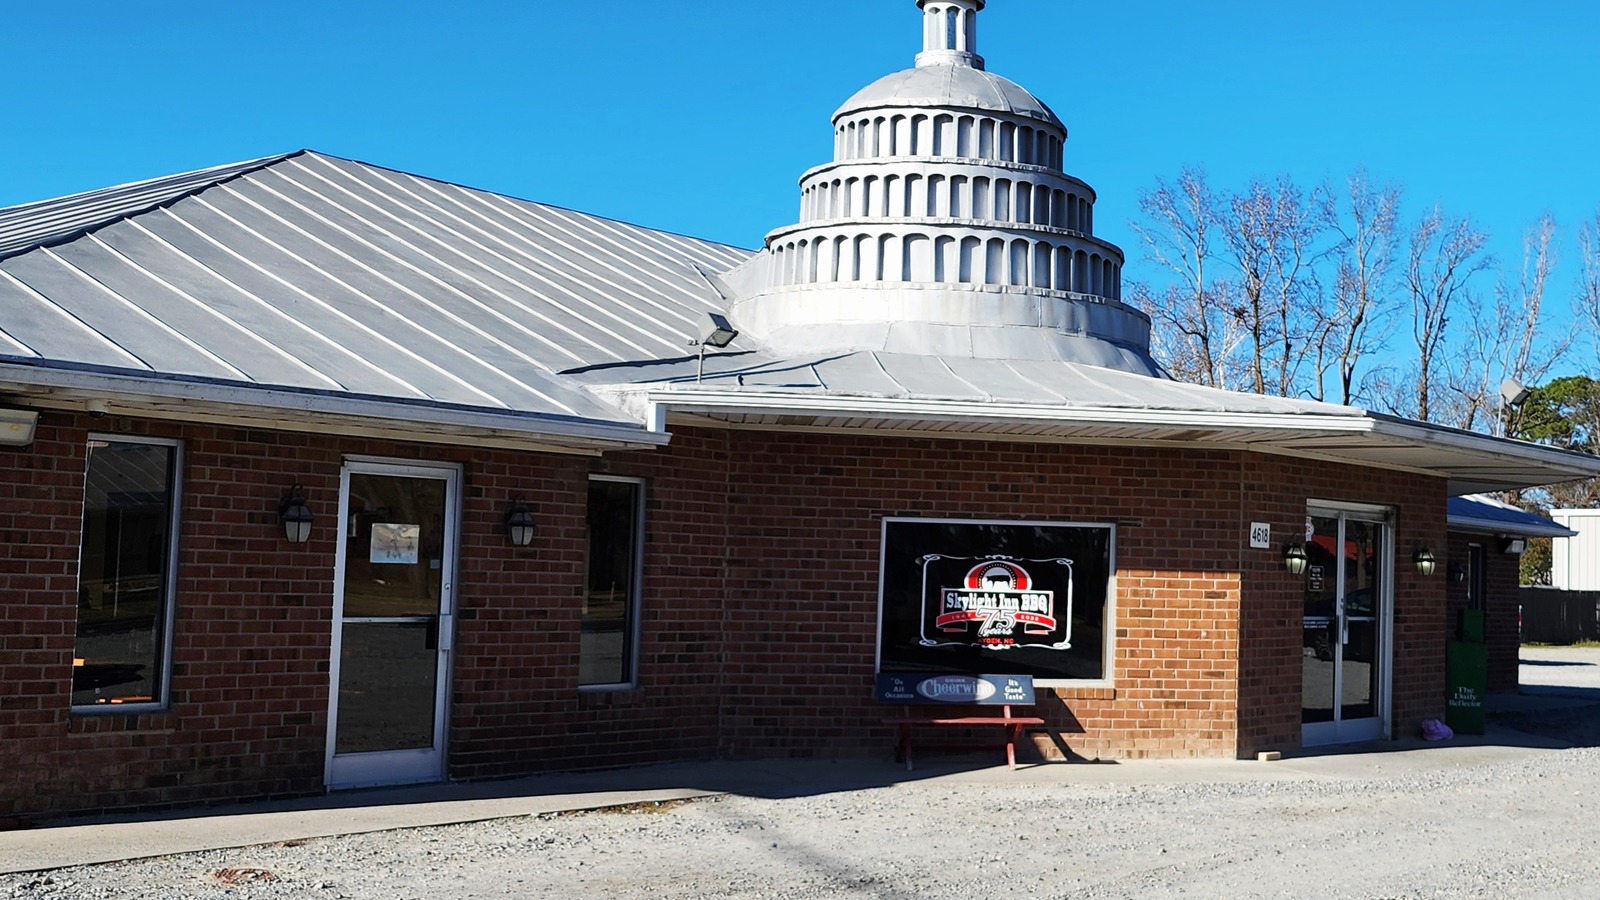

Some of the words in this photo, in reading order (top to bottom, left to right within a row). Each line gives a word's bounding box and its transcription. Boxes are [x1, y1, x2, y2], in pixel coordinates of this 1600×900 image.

[1252, 527, 1269, 543] 4618
[946, 592, 997, 611] Skylight
[998, 594, 1020, 611] Inn
[1021, 594, 1048, 614] BBQ
[975, 607, 1017, 637] 75
[982, 626, 1013, 637] years
[921, 679, 991, 698] Cheerwine
[1454, 692, 1477, 701] Daily
[1449, 699, 1481, 707] Reflector
